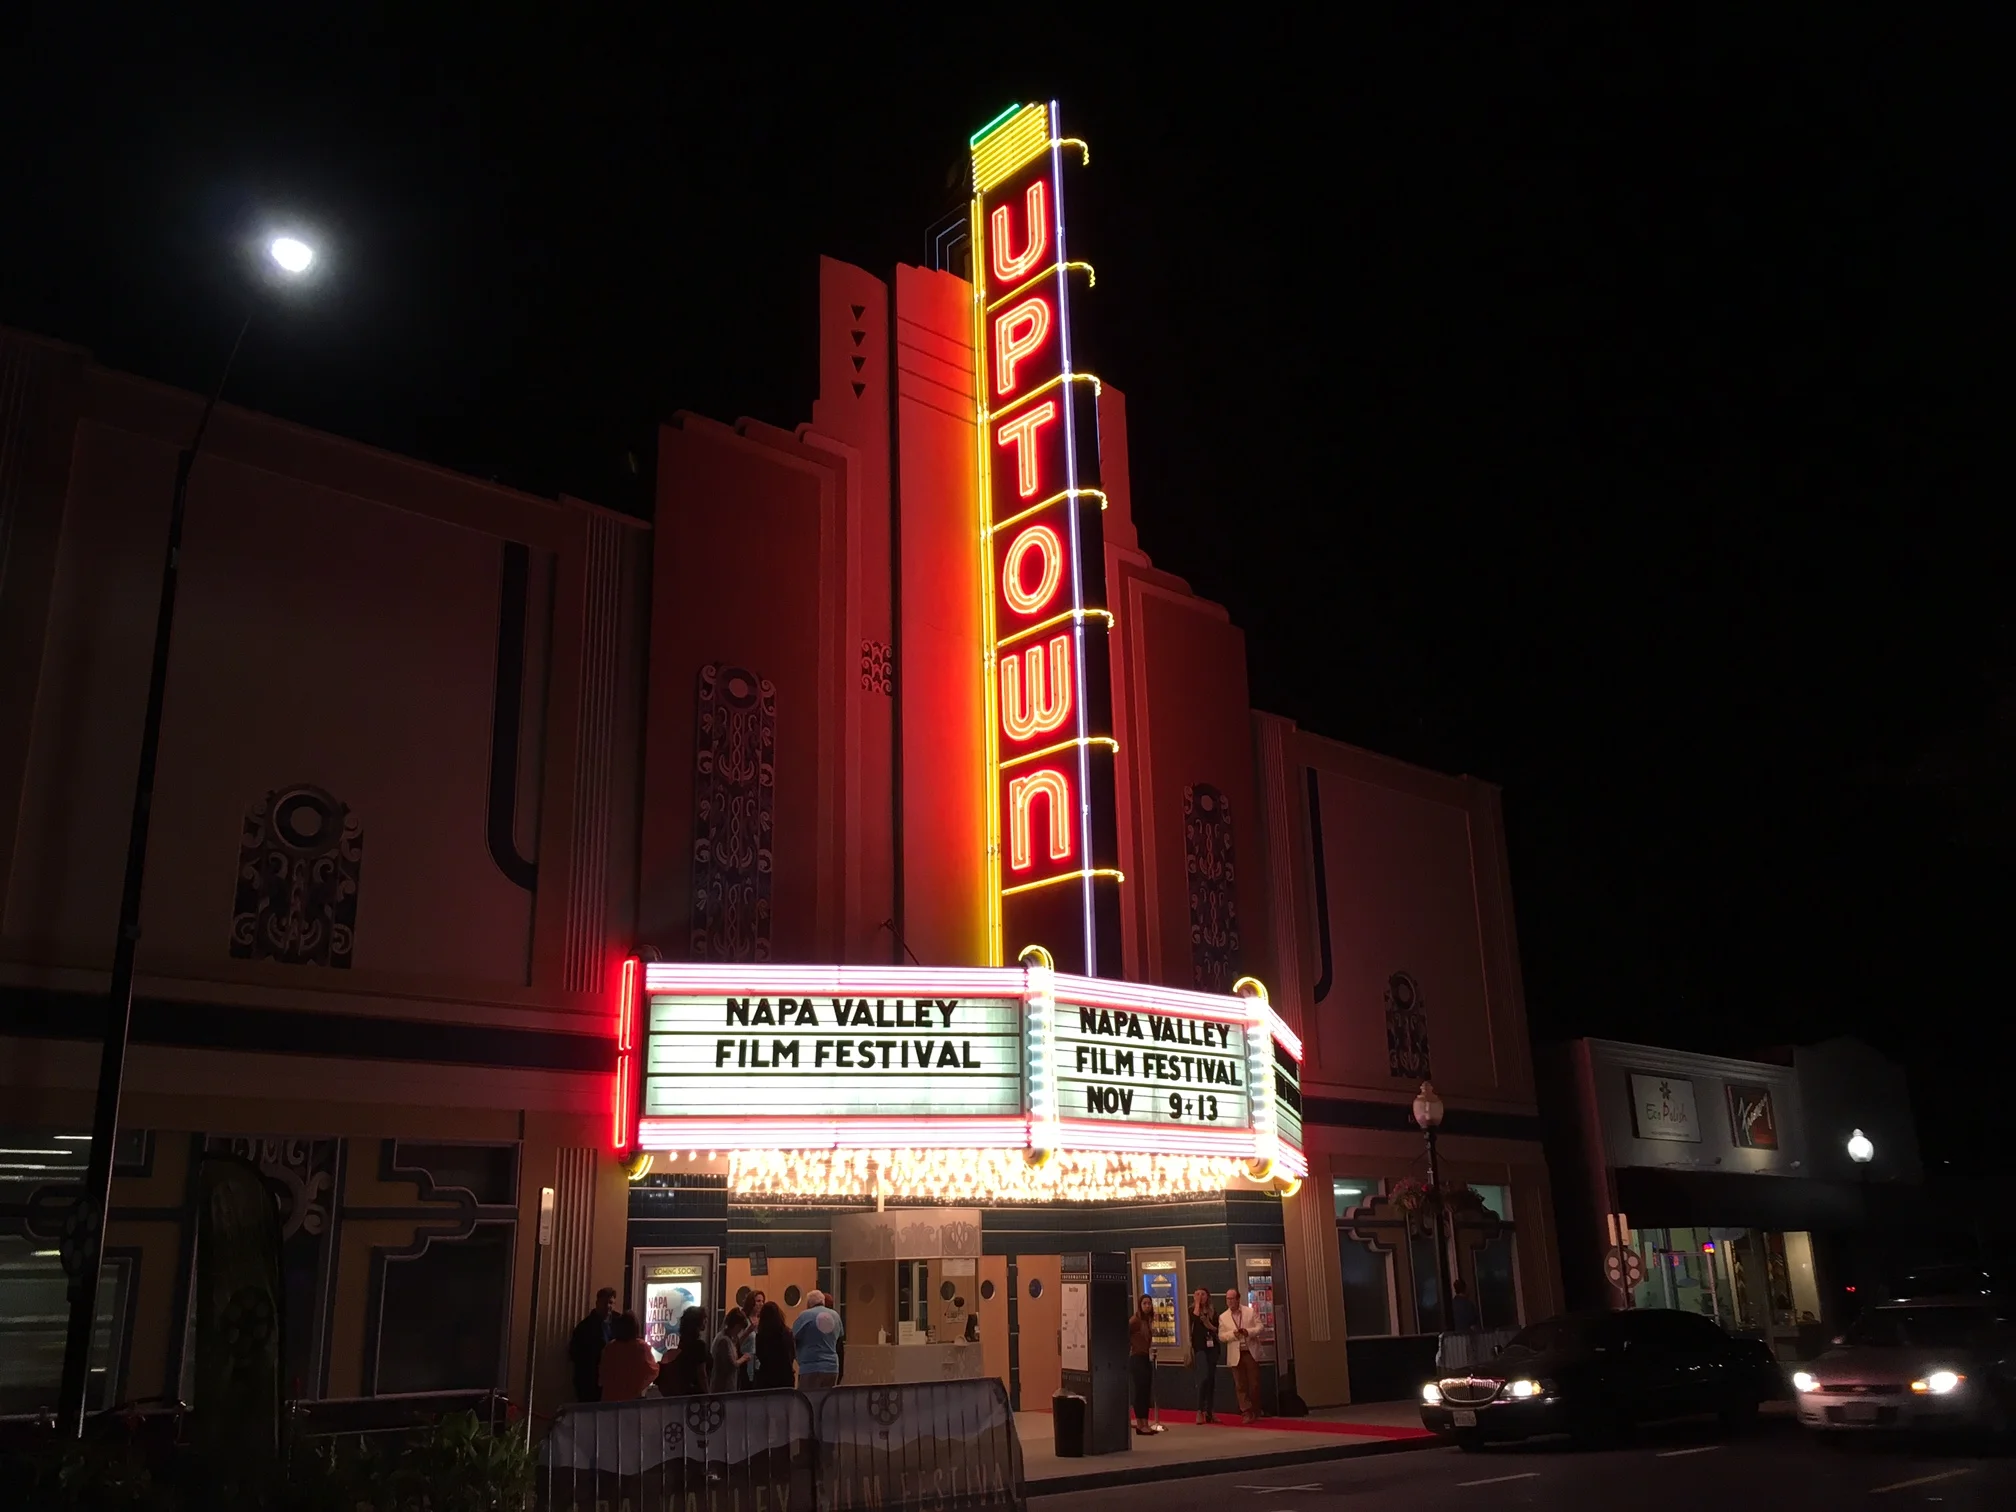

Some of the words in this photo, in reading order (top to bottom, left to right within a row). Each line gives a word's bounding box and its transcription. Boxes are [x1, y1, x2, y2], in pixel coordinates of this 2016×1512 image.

[991, 180, 1072, 871] UPTOWN
[726, 998, 819, 1026] NAPA
[832, 999, 958, 1028] VALLEY
[1079, 1007, 1144, 1039] NAPA
[1148, 1015, 1230, 1049] VALLEY
[715, 1039, 799, 1067] FILM
[814, 1040, 981, 1069] FESTIVAL
[1076, 1046, 1135, 1077] FILM
[1143, 1052, 1243, 1086] FESTIVAL
[1086, 1086, 1134, 1115] NOV
[678, 1267, 696, 1275] SOON
[648, 1309, 673, 1321] VALLEY
